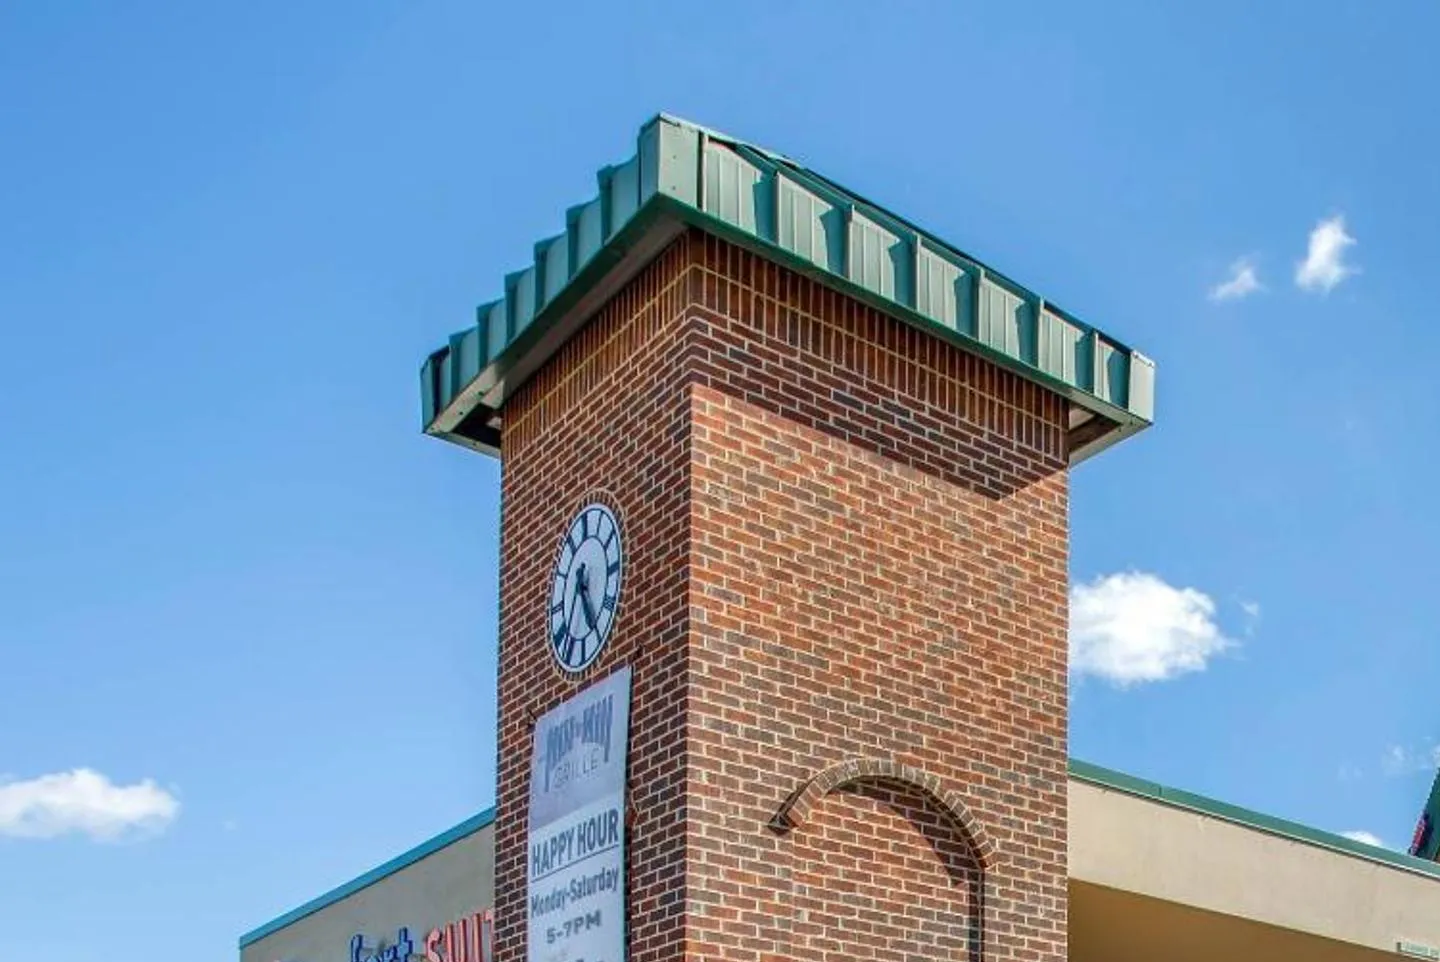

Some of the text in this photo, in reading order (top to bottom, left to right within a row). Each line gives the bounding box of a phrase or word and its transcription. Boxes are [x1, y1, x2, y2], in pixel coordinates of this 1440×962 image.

[532, 808, 619, 877] HAPPY HOUR
[531, 867, 619, 918] Monday-Saturday
[546, 909, 602, 945] 5-7PM
